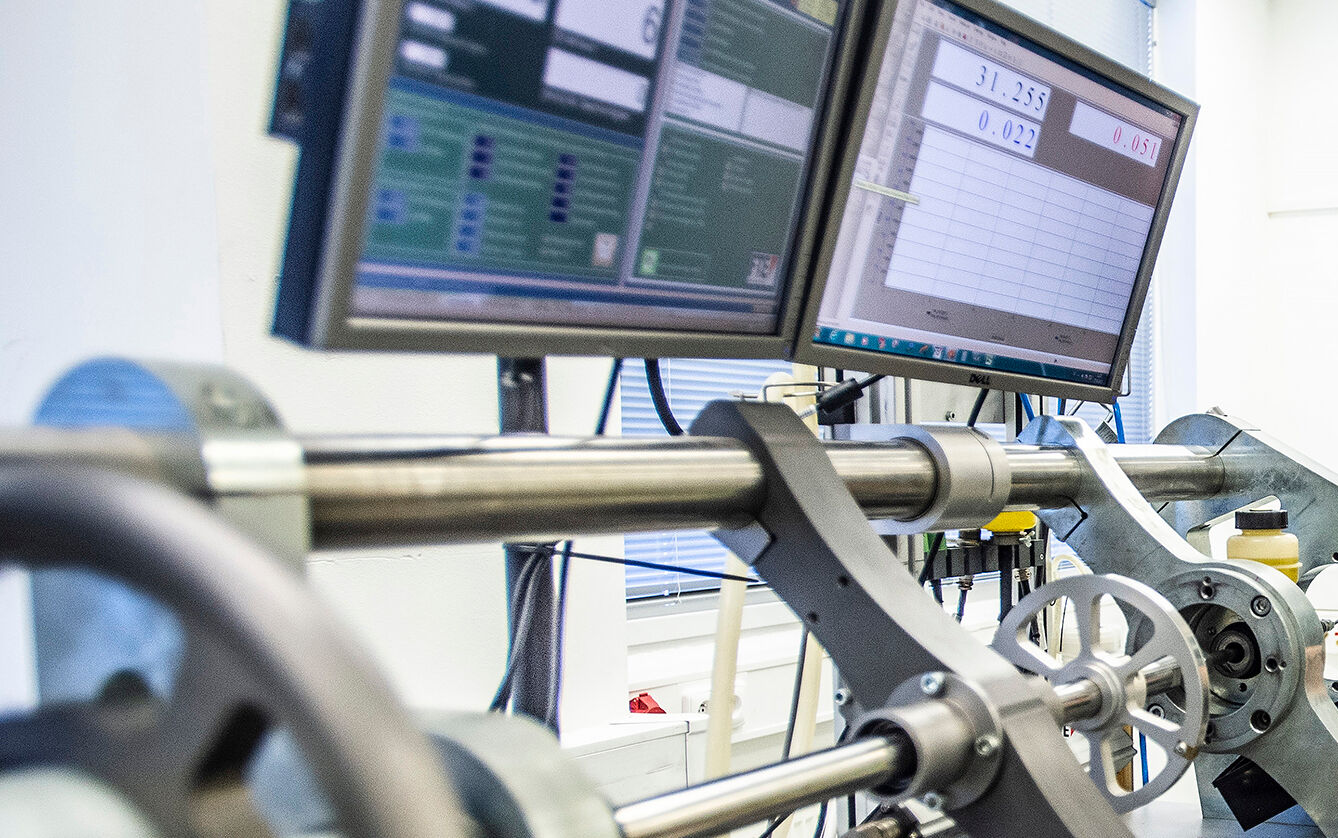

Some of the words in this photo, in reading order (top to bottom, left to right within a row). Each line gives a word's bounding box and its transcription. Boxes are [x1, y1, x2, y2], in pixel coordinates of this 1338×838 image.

[642, 5, 660, 43] 6
[975, 65, 1046, 111] 31.255
[978, 110, 1036, 149] 0.022
[1112, 126, 1157, 160] 0.051
[970, 373, 990, 385] DELL
